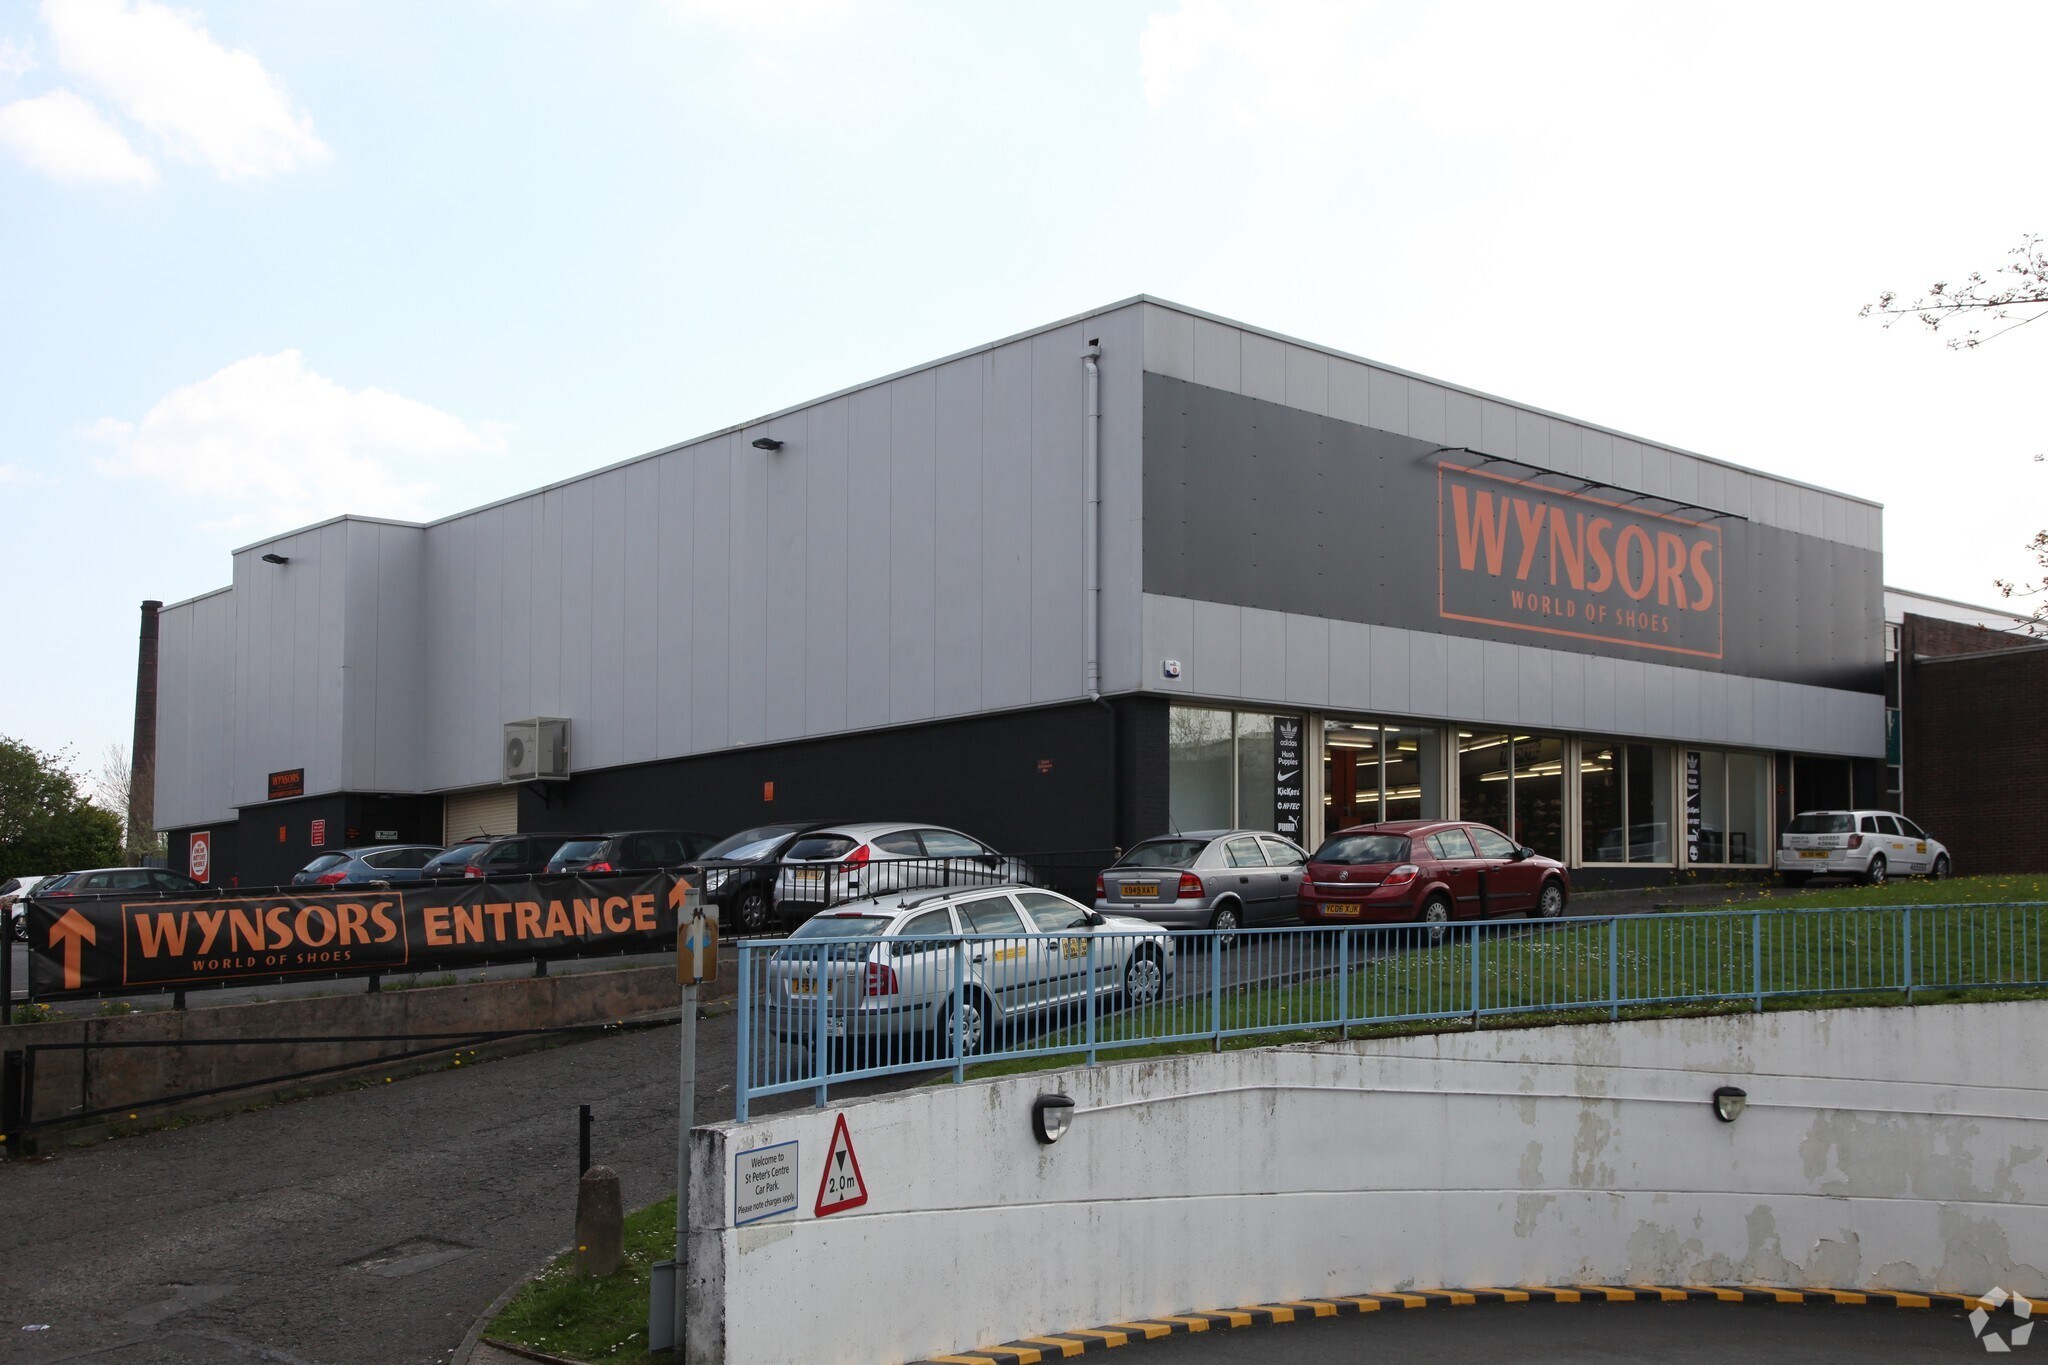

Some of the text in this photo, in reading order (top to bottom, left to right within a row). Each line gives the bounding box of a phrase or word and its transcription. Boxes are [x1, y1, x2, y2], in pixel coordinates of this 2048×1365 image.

[1452, 484, 1714, 612] WYNSORS
[1511, 590, 1669, 633] WORLD OF SHOES
[1124, 886, 1155, 894] X949 XAT
[1345, 905, 1359, 913] XJK
[135, 902, 397, 958] WYNSORS
[423, 894, 657, 946] ENTRANCE
[193, 950, 351, 971] WORLD OF SHOES
[751, 1153, 785, 1168] Welcome to
[745, 1165, 789, 1184] St Peter's Centre
[829, 1175, 855, 1193] 2.0m
[755, 1181, 779, 1195] Car Park.
[738, 1192, 795, 1214] Please note charges apply.
